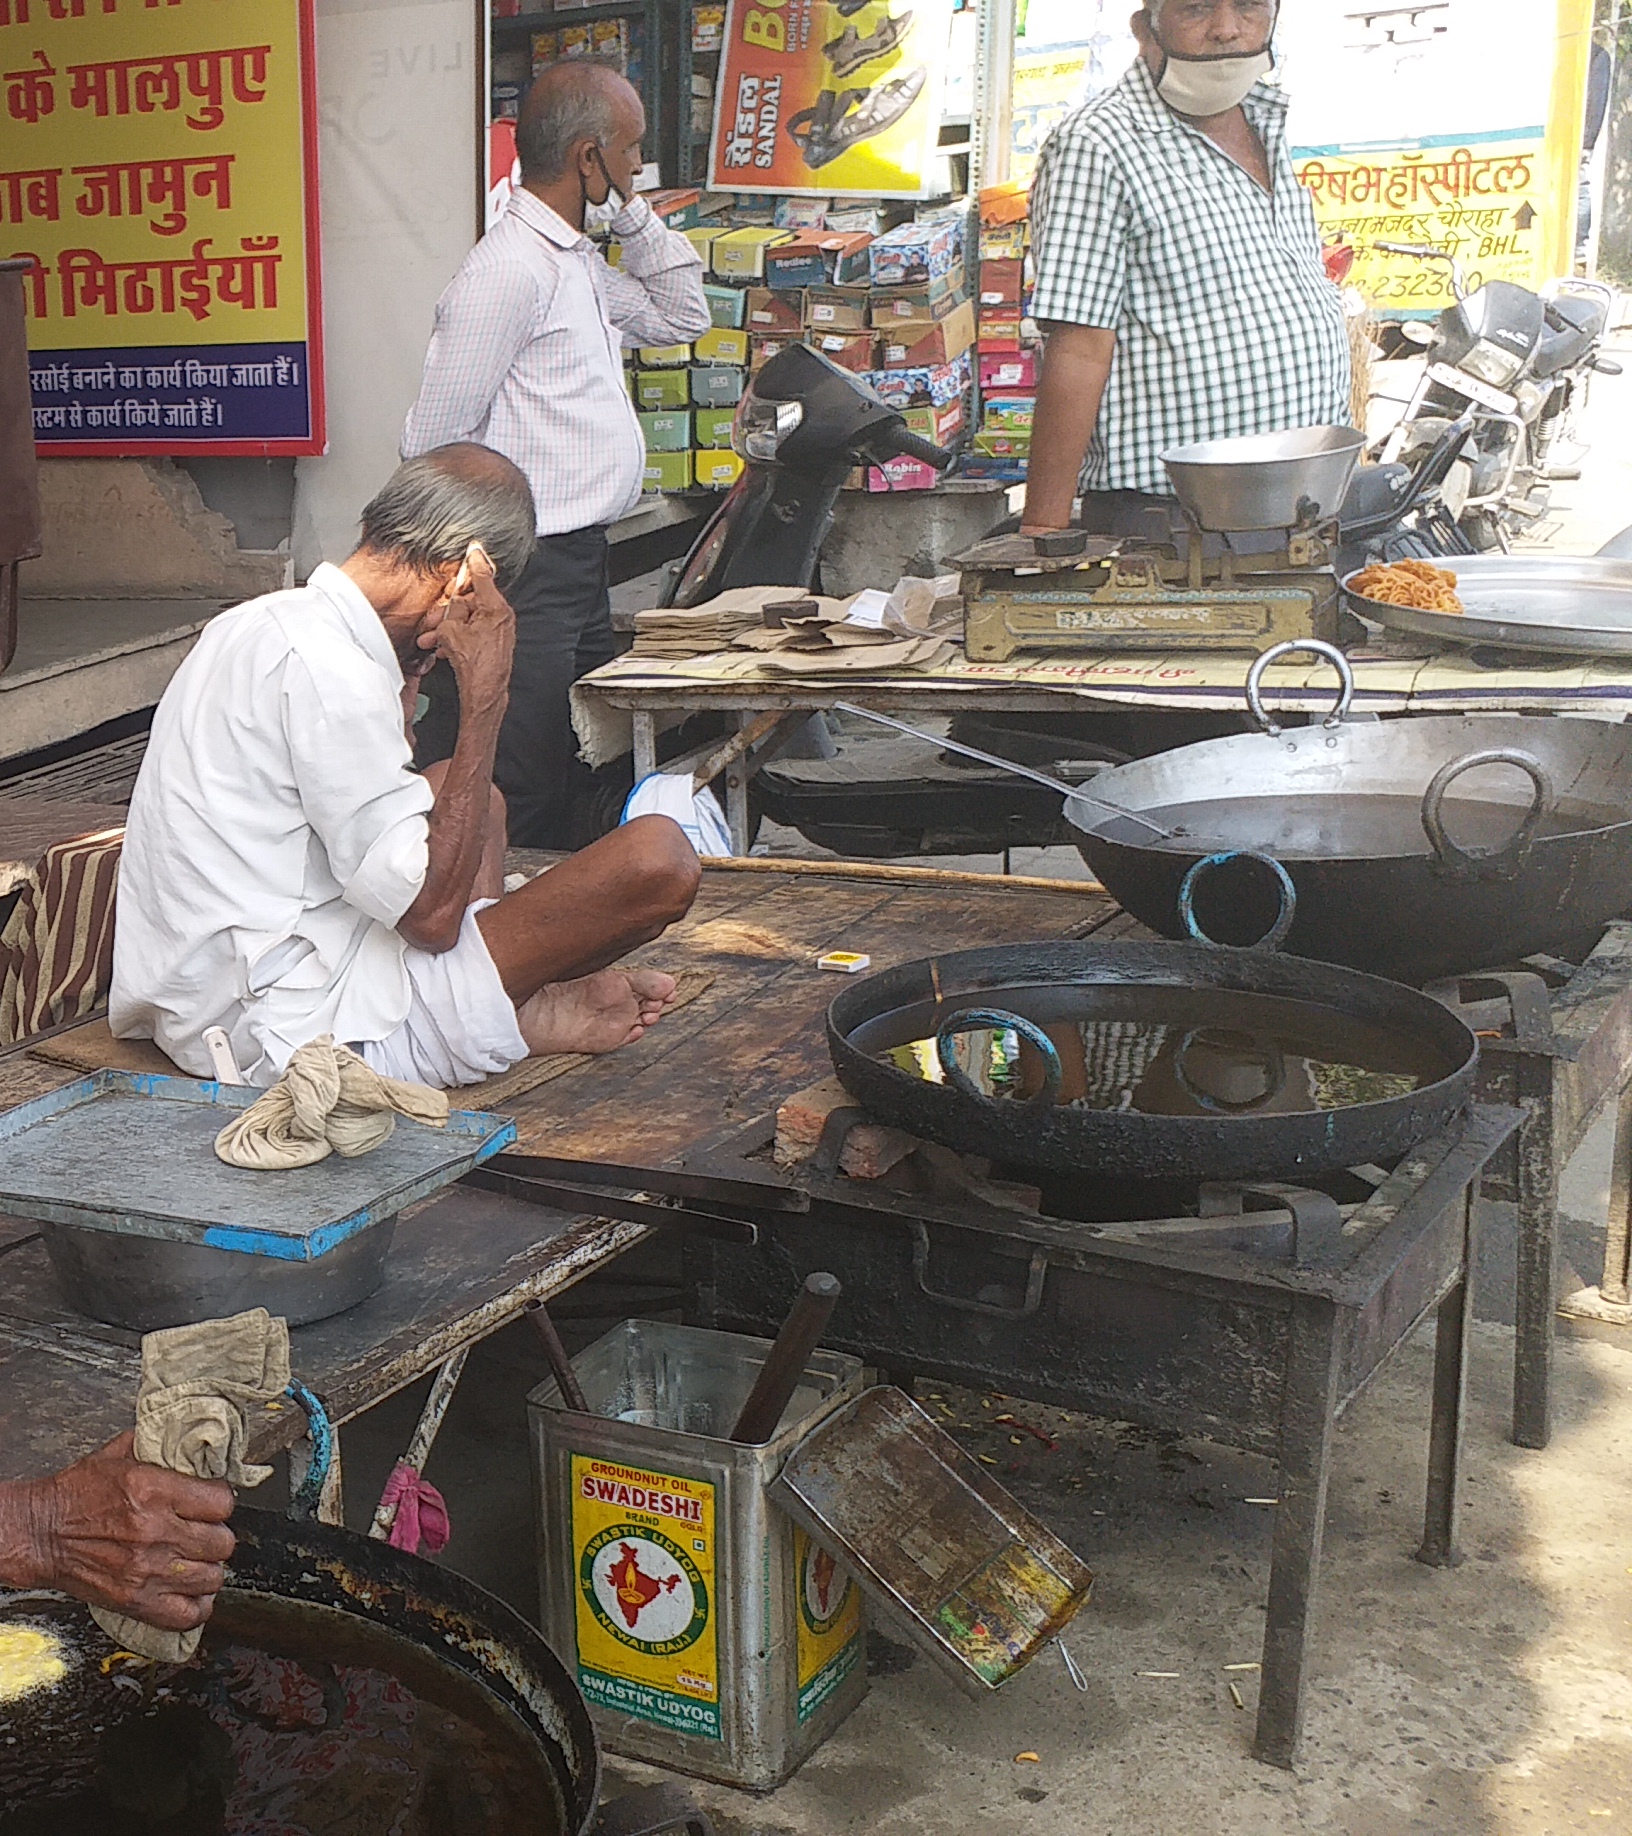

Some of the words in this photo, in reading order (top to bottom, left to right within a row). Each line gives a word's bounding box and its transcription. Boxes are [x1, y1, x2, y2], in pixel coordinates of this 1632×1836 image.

[5, 51, 56, 123] के
[67, 45, 271, 131] मालपुए
[754, 74, 782, 168] SANDAL
[71, 154, 236, 236] जामुन
[1437, 200, 1511, 238] चौराहा
[59, 235, 282, 322] मिठाईयाँ
[71, 361, 117, 390] बनाने
[118, 366, 143, 389] का
[144, 359, 183, 389] कार्य
[184, 359, 229, 388] किया
[229, 363, 273, 387] जाता
[68, 400, 84, 428] से
[85, 398, 122, 427] कार्य
[123, 398, 162, 427] किये
[162, 397, 199, 426] जाते
[582, 1476, 702, 1521] SWADESHI
[591, 1462, 668, 1487] GROUNDNUT
[671, 1479, 692, 1493] OIL
[625, 1511, 660, 1526] BRAND
[586, 1526, 647, 1557] SWASTIK
[651, 1533, 700, 1582] UDYOG
[598, 1612, 645, 1650] NEWAI
[581, 1674, 655, 1708] SWASTIK
[657, 1697, 716, 1724] UDYOG
